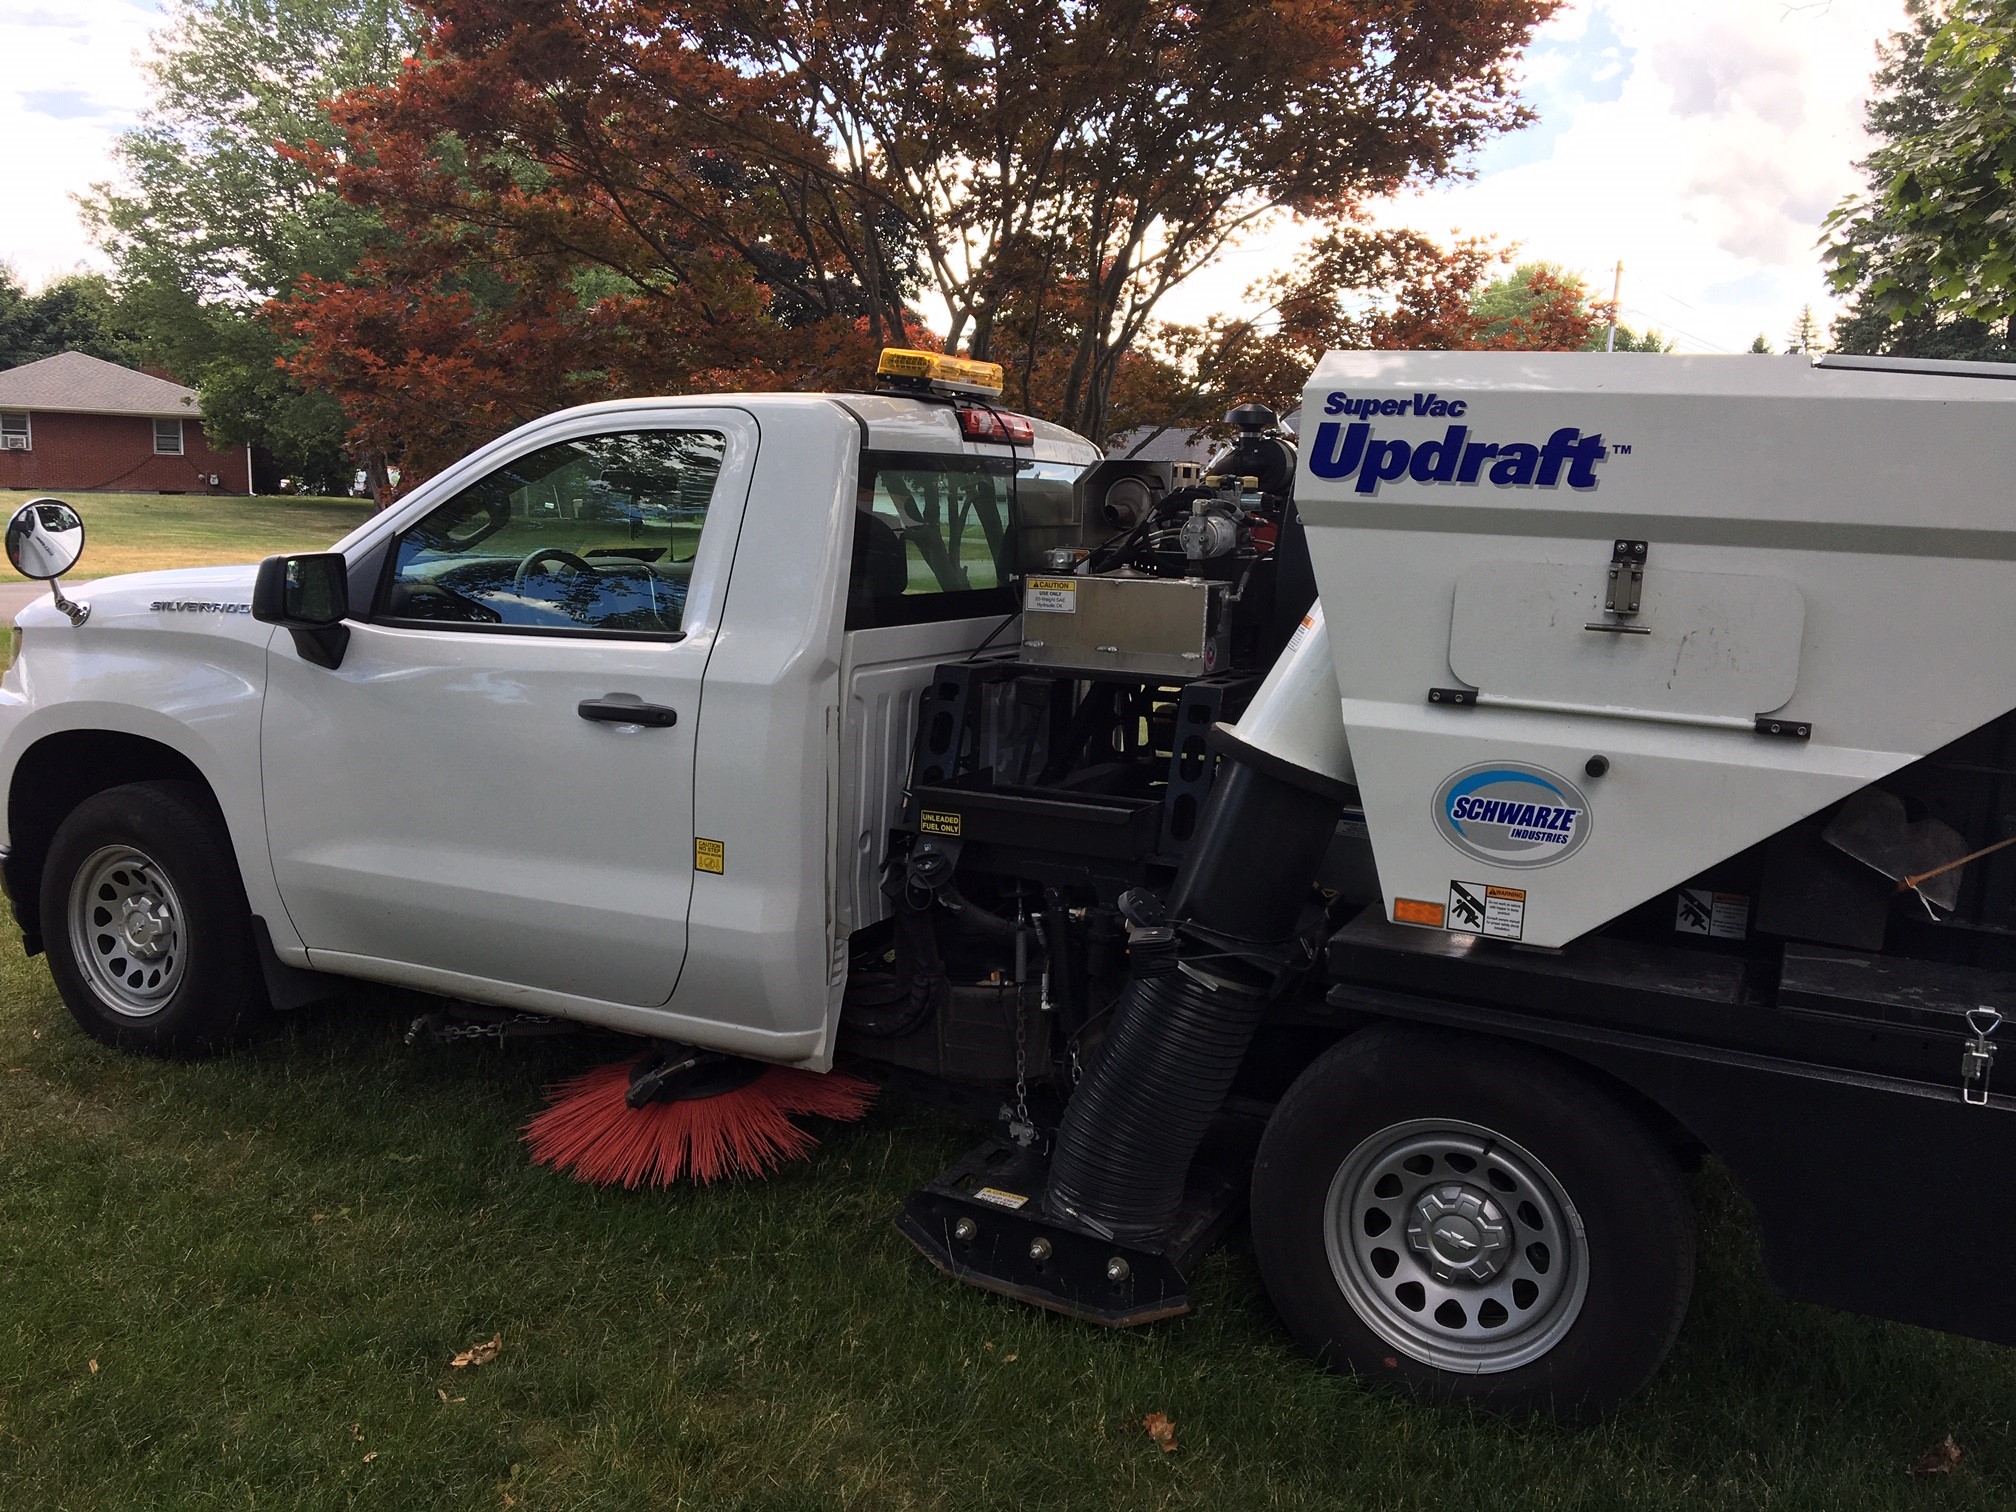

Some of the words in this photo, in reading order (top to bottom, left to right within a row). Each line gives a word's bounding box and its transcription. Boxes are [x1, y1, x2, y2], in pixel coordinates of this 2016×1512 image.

[1324, 391, 1468, 421] SuperVac
[1309, 421, 1609, 496] Updraft
[1039, 581, 1069, 589] CAUTION
[150, 601, 252, 613] SILVERADO
[922, 813, 959, 824] UNLEADED
[1453, 796, 1577, 832] SCHWARZE
[922, 822, 940, 831] FUEL
[940, 824, 959, 833] ONLY
[1510, 828, 1569, 844] INDUSTRIES
[698, 840, 721, 849] CAUTION
[1495, 889, 1523, 899] WARNING
